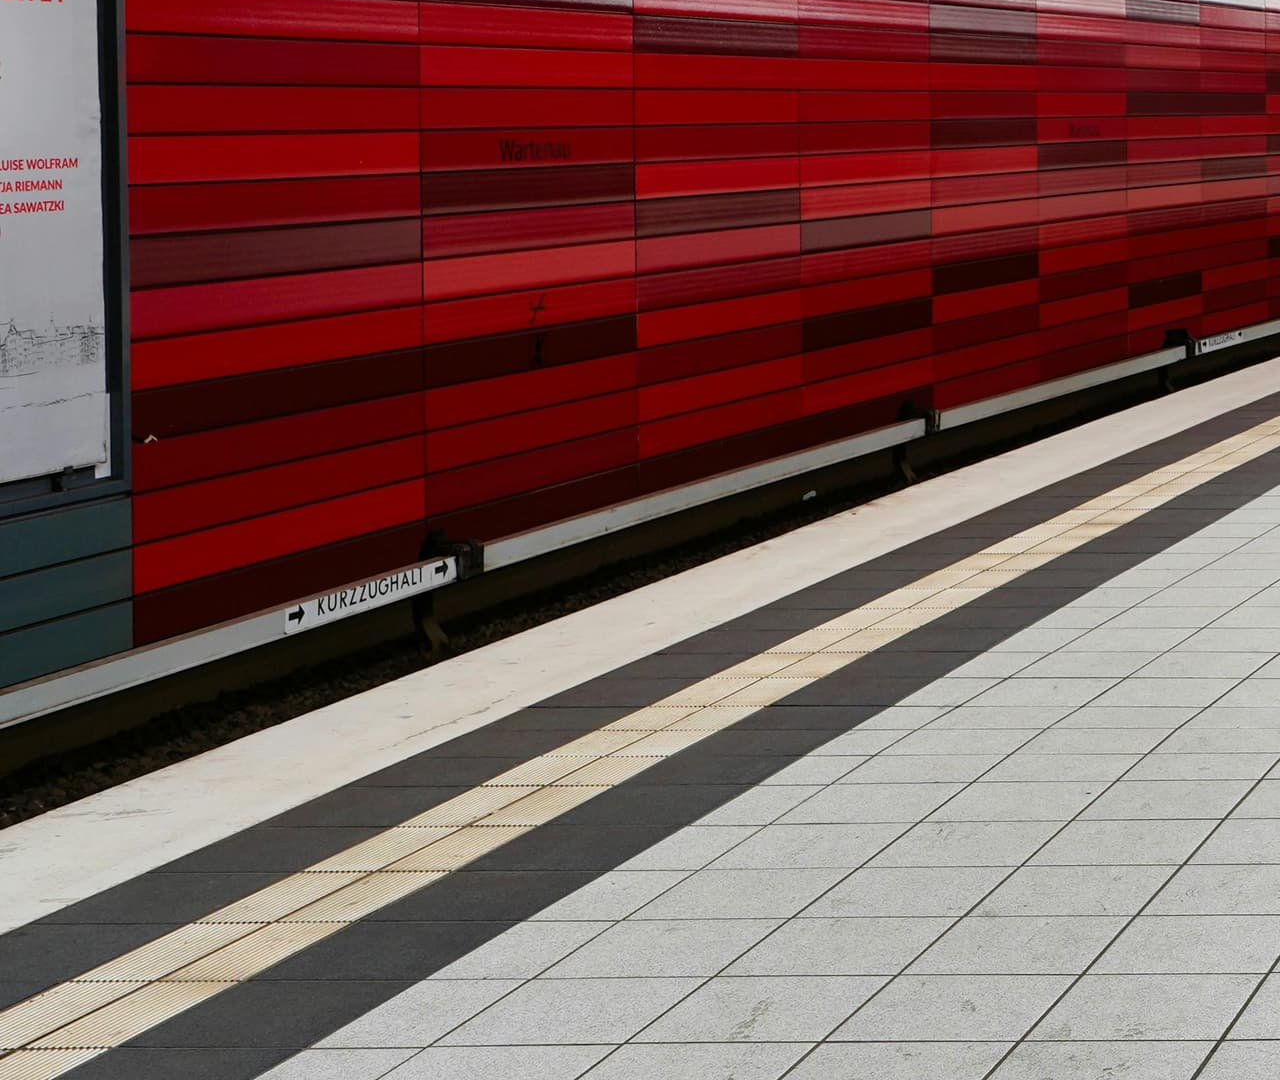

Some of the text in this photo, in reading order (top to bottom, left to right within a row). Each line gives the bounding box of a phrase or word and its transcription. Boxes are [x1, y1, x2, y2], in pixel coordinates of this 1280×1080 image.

[498, 138, 572, 162] Wartenau
[26, 157, 79, 169] WOLFRAM
[15, 179, 63, 192] RIEMANN
[14, 200, 65, 213] SAWATZKI
[317, 567, 425, 616] KURZZUGHALT
